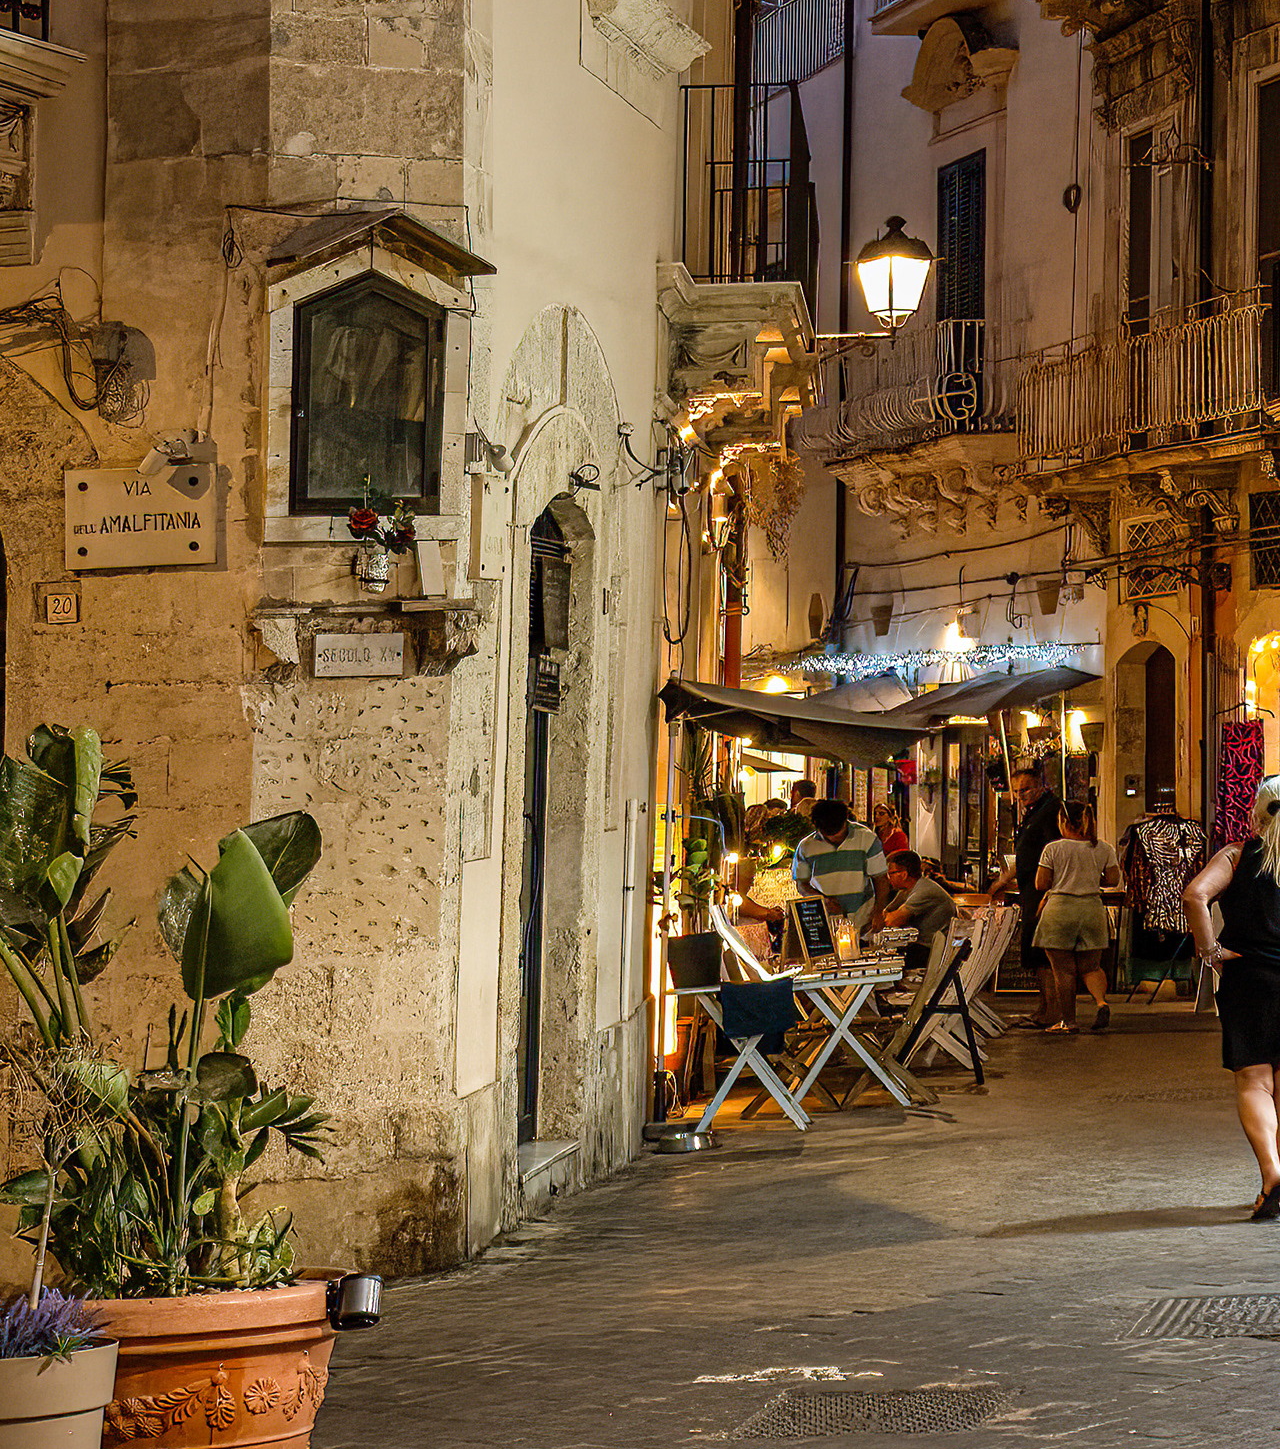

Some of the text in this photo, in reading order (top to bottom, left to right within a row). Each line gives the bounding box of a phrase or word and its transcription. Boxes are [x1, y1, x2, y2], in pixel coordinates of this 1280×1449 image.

[123, 481, 152, 496] VIA
[100, 511, 201, 535] AMALFITANIA
[52, 596, 72, 614] 20
